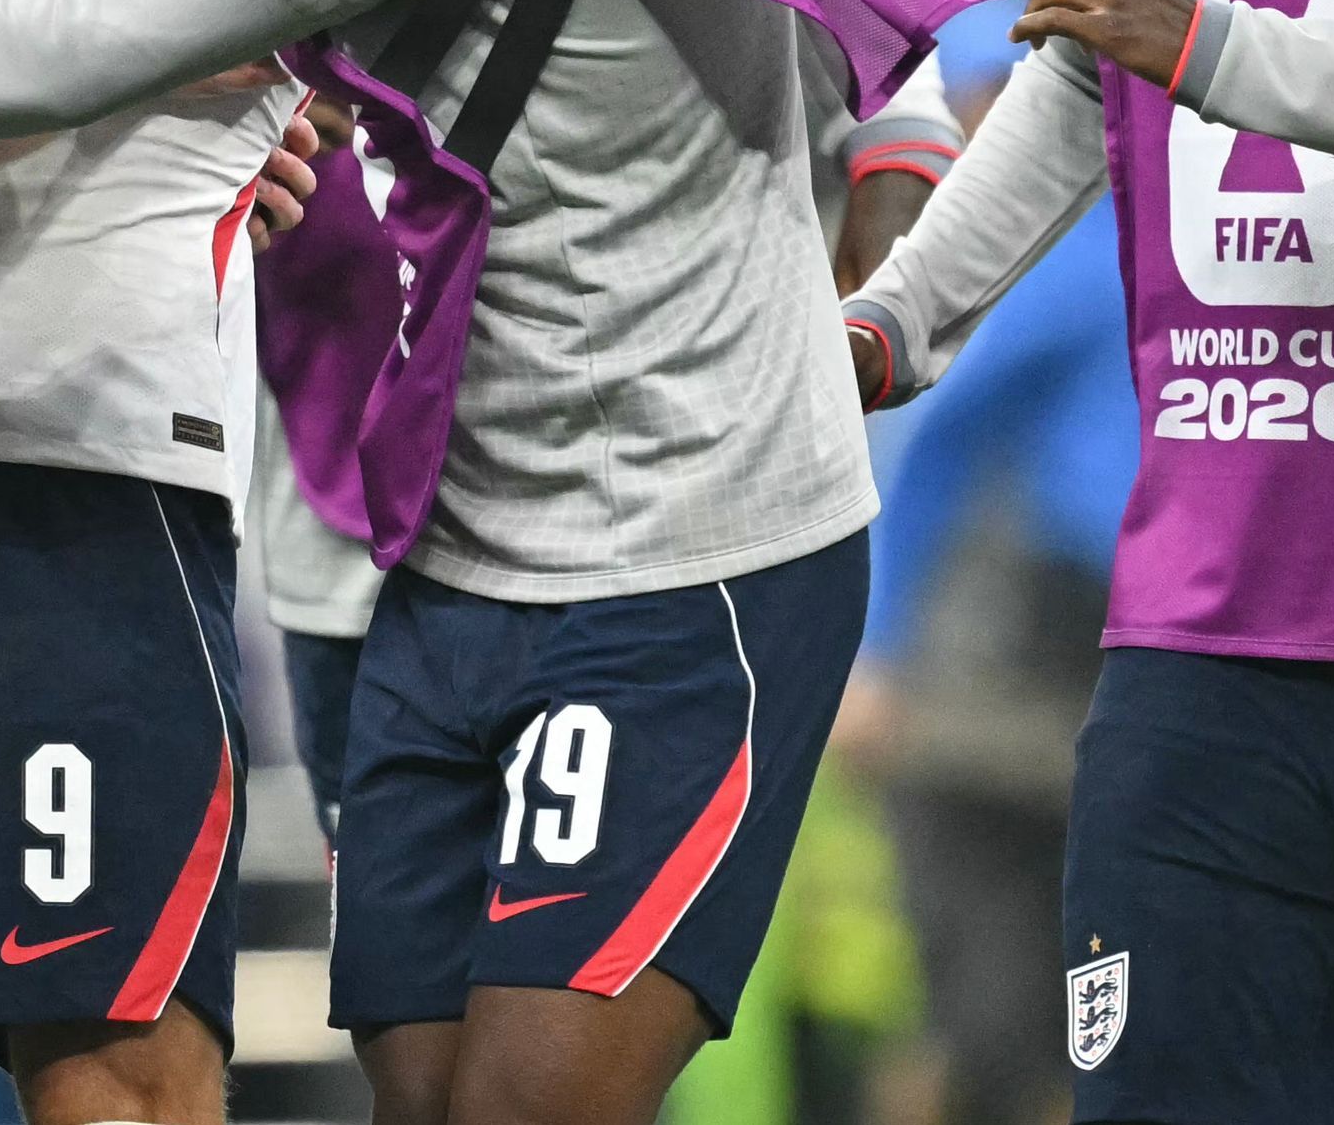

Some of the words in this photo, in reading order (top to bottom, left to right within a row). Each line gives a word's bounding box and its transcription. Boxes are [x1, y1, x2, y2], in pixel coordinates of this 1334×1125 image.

[1215, 217, 1314, 263] FIFA
[1170, 328, 1279, 367] WORLD
[24, 743, 92, 904] 9
[499, 703, 613, 866] 19
